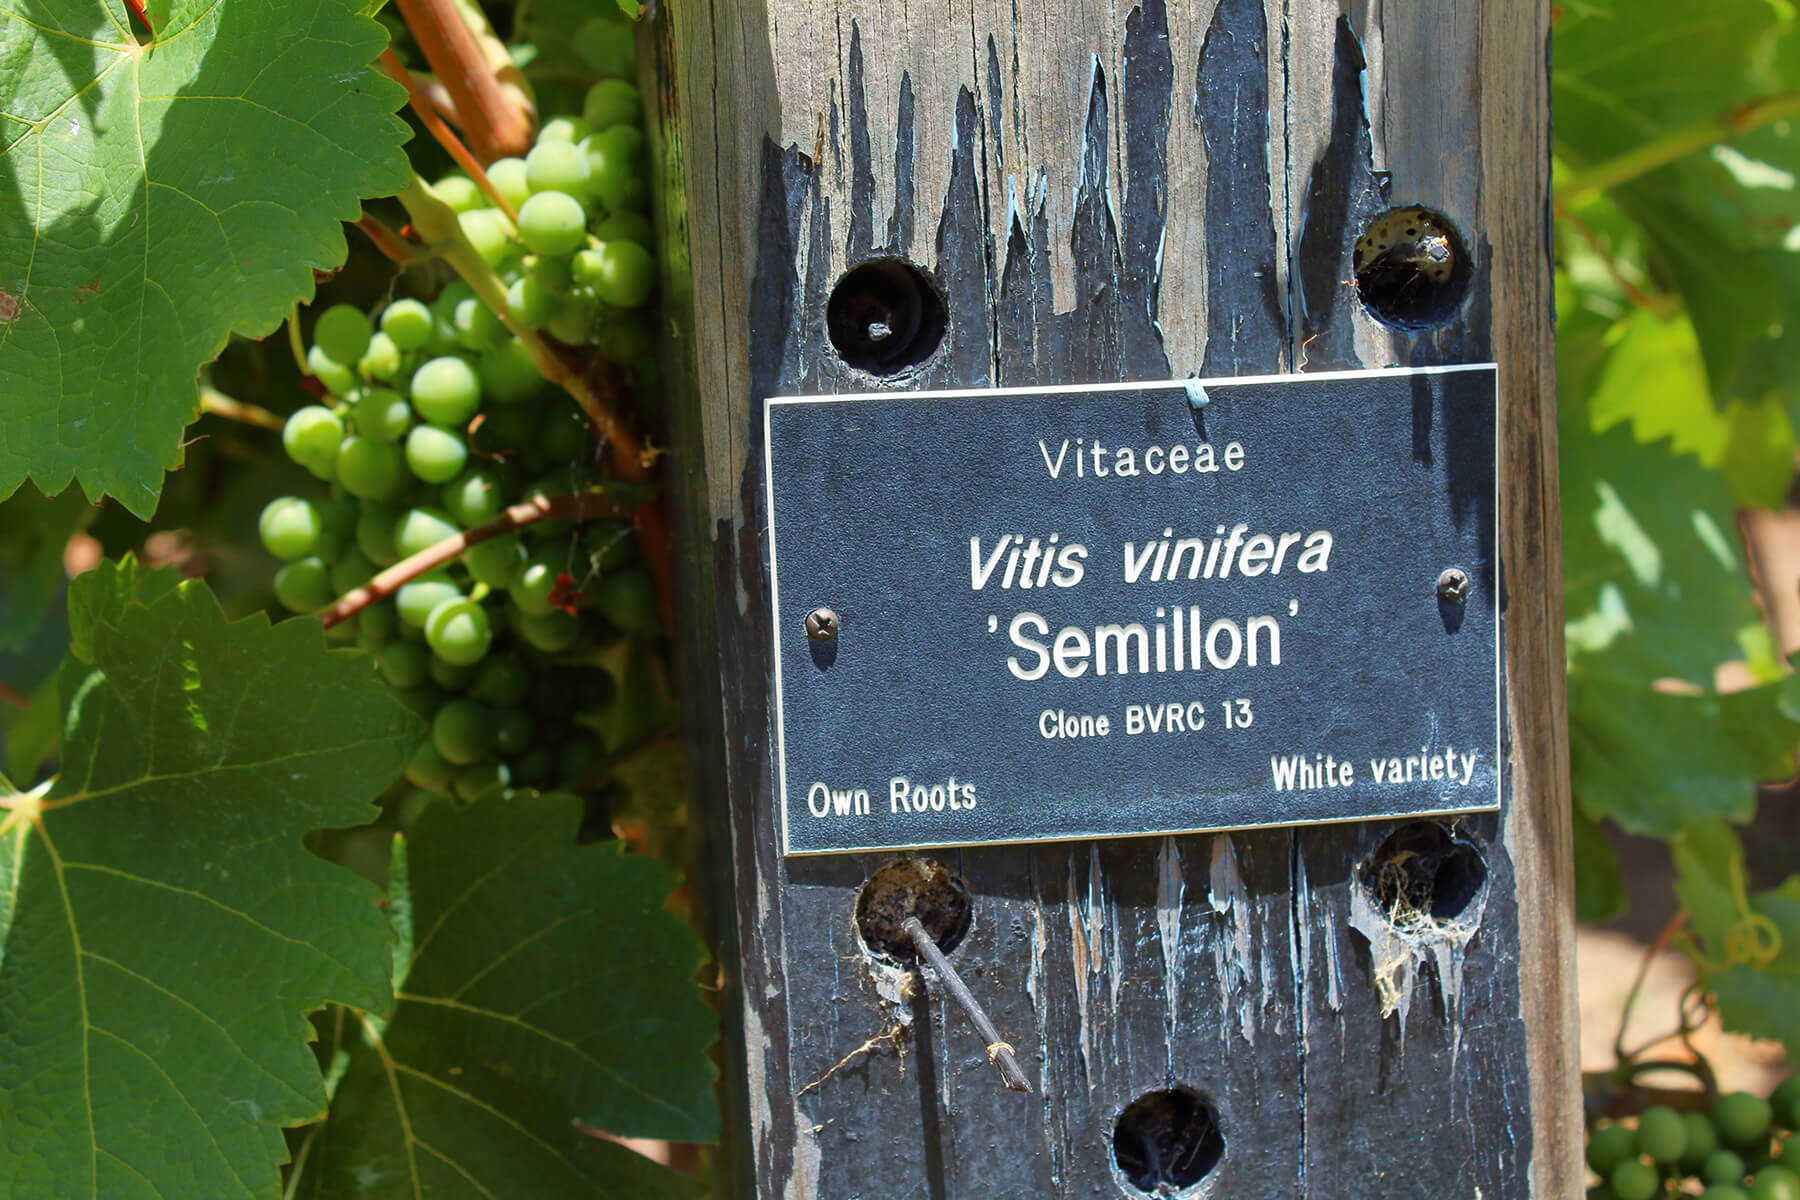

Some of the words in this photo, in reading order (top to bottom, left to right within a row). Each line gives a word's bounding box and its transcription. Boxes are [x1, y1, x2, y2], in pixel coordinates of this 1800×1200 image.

[1038, 437, 1245, 478] Vitaceae
[969, 532, 1089, 591] Vitis
[1124, 521, 1333, 584] vinifera
[1038, 705, 1110, 740] Clone
[1125, 701, 1206, 735] BVRC
[1221, 698, 1254, 730] 13
[1270, 752, 1355, 794] White
[1370, 746, 1477, 787] variety
[807, 781, 871, 819] Own
[889, 775, 978, 815] Roots
